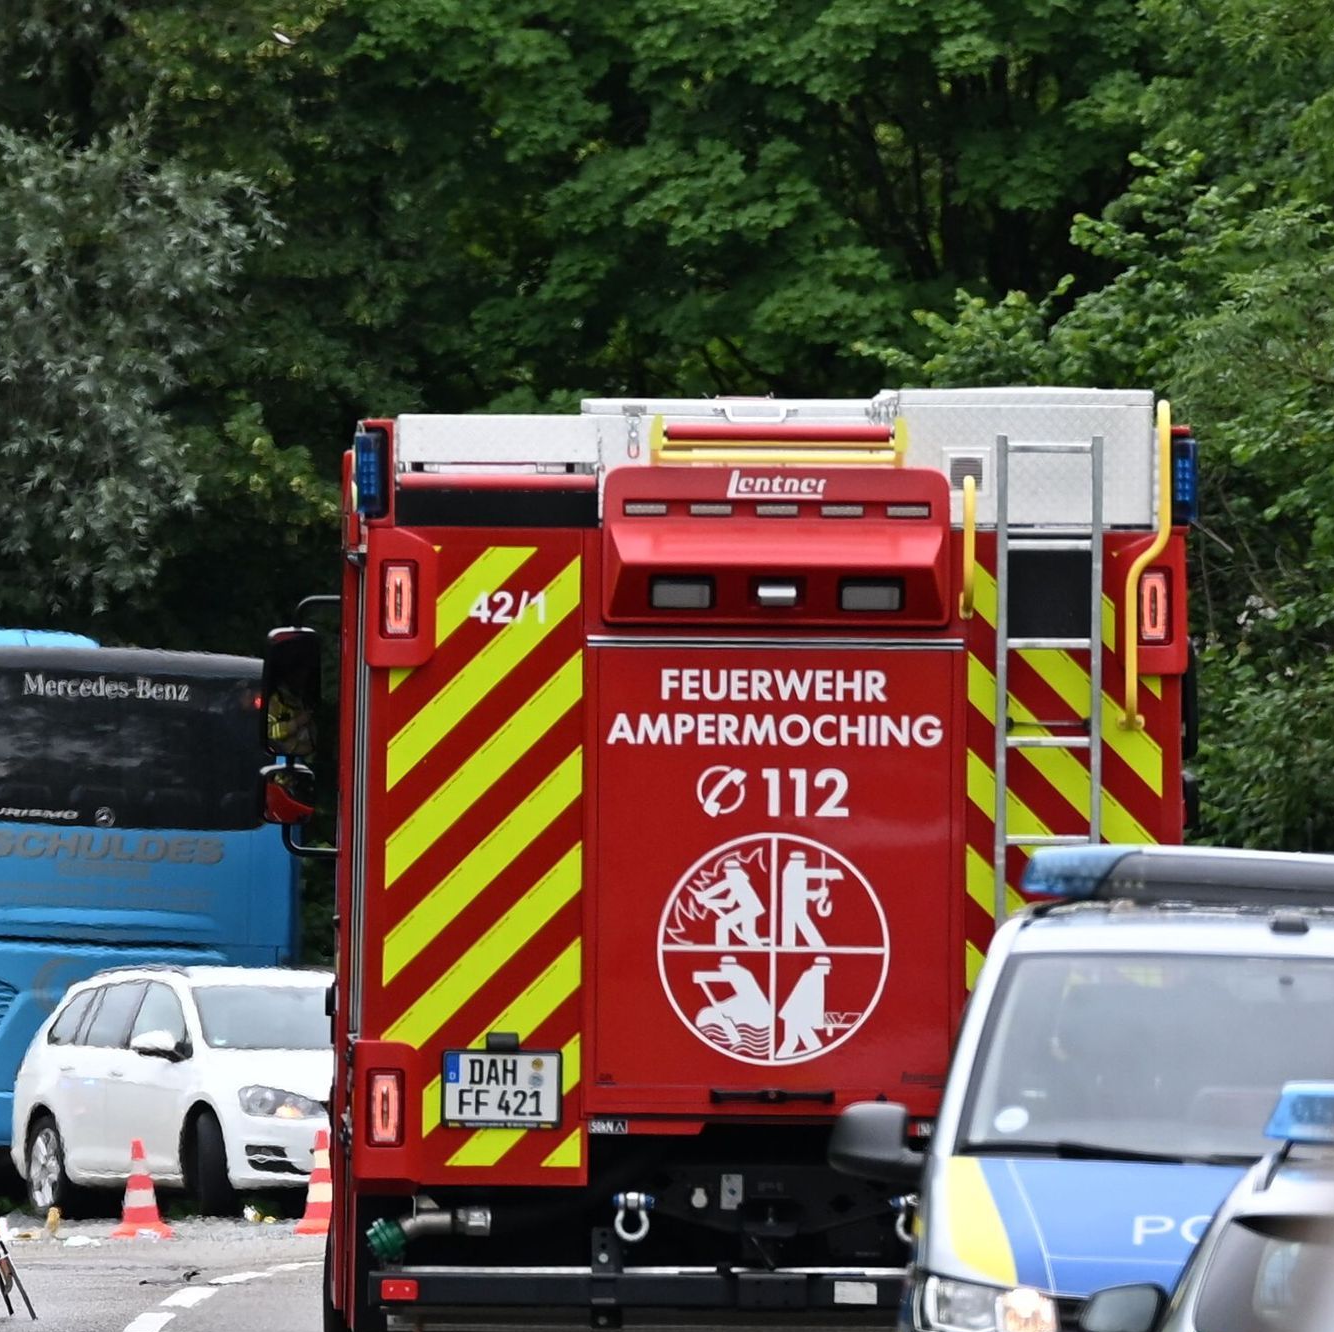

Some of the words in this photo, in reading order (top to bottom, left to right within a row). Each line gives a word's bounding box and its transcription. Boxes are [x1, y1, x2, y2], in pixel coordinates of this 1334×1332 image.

[726, 469, 827, 500] Lentner
[469, 590, 546, 625] 42/1
[23, 671, 191, 702] Mercedes-Benz
[660, 668, 888, 702] FEUERWEHR
[605, 712, 945, 748] AMPERMOCHING
[761, 767, 850, 818] 112
[469, 1058, 518, 1086] DAH
[458, 1089, 490, 1116] FF
[497, 1090, 543, 1117] 421
